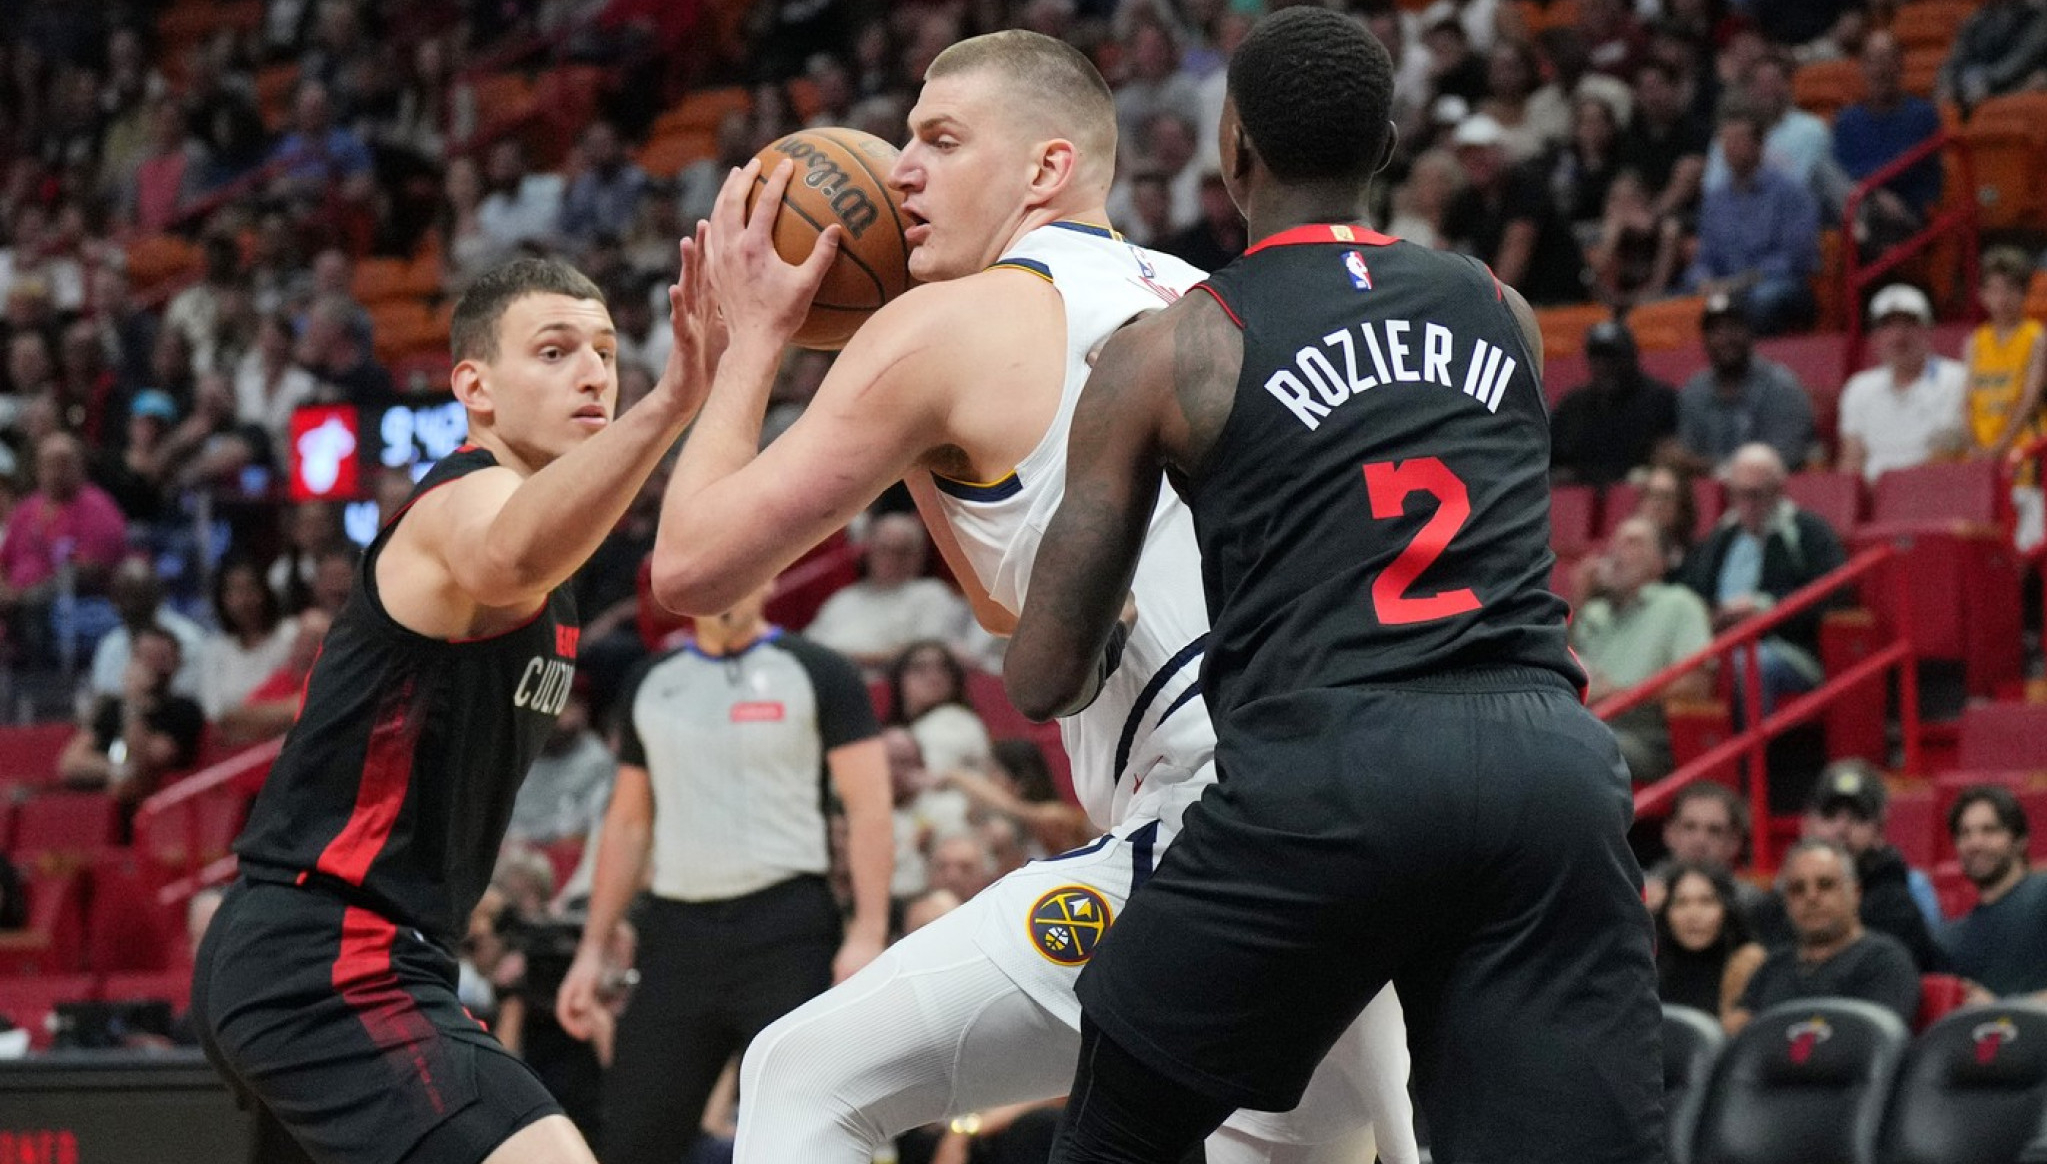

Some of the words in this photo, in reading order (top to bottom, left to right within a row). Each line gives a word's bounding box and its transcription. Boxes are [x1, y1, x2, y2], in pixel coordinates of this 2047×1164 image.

[774, 136, 879, 240] Wilson
[1264, 319, 1453, 431] ROZIER
[1463, 338, 1517, 414] III
[1362, 456, 1483, 625] 2
